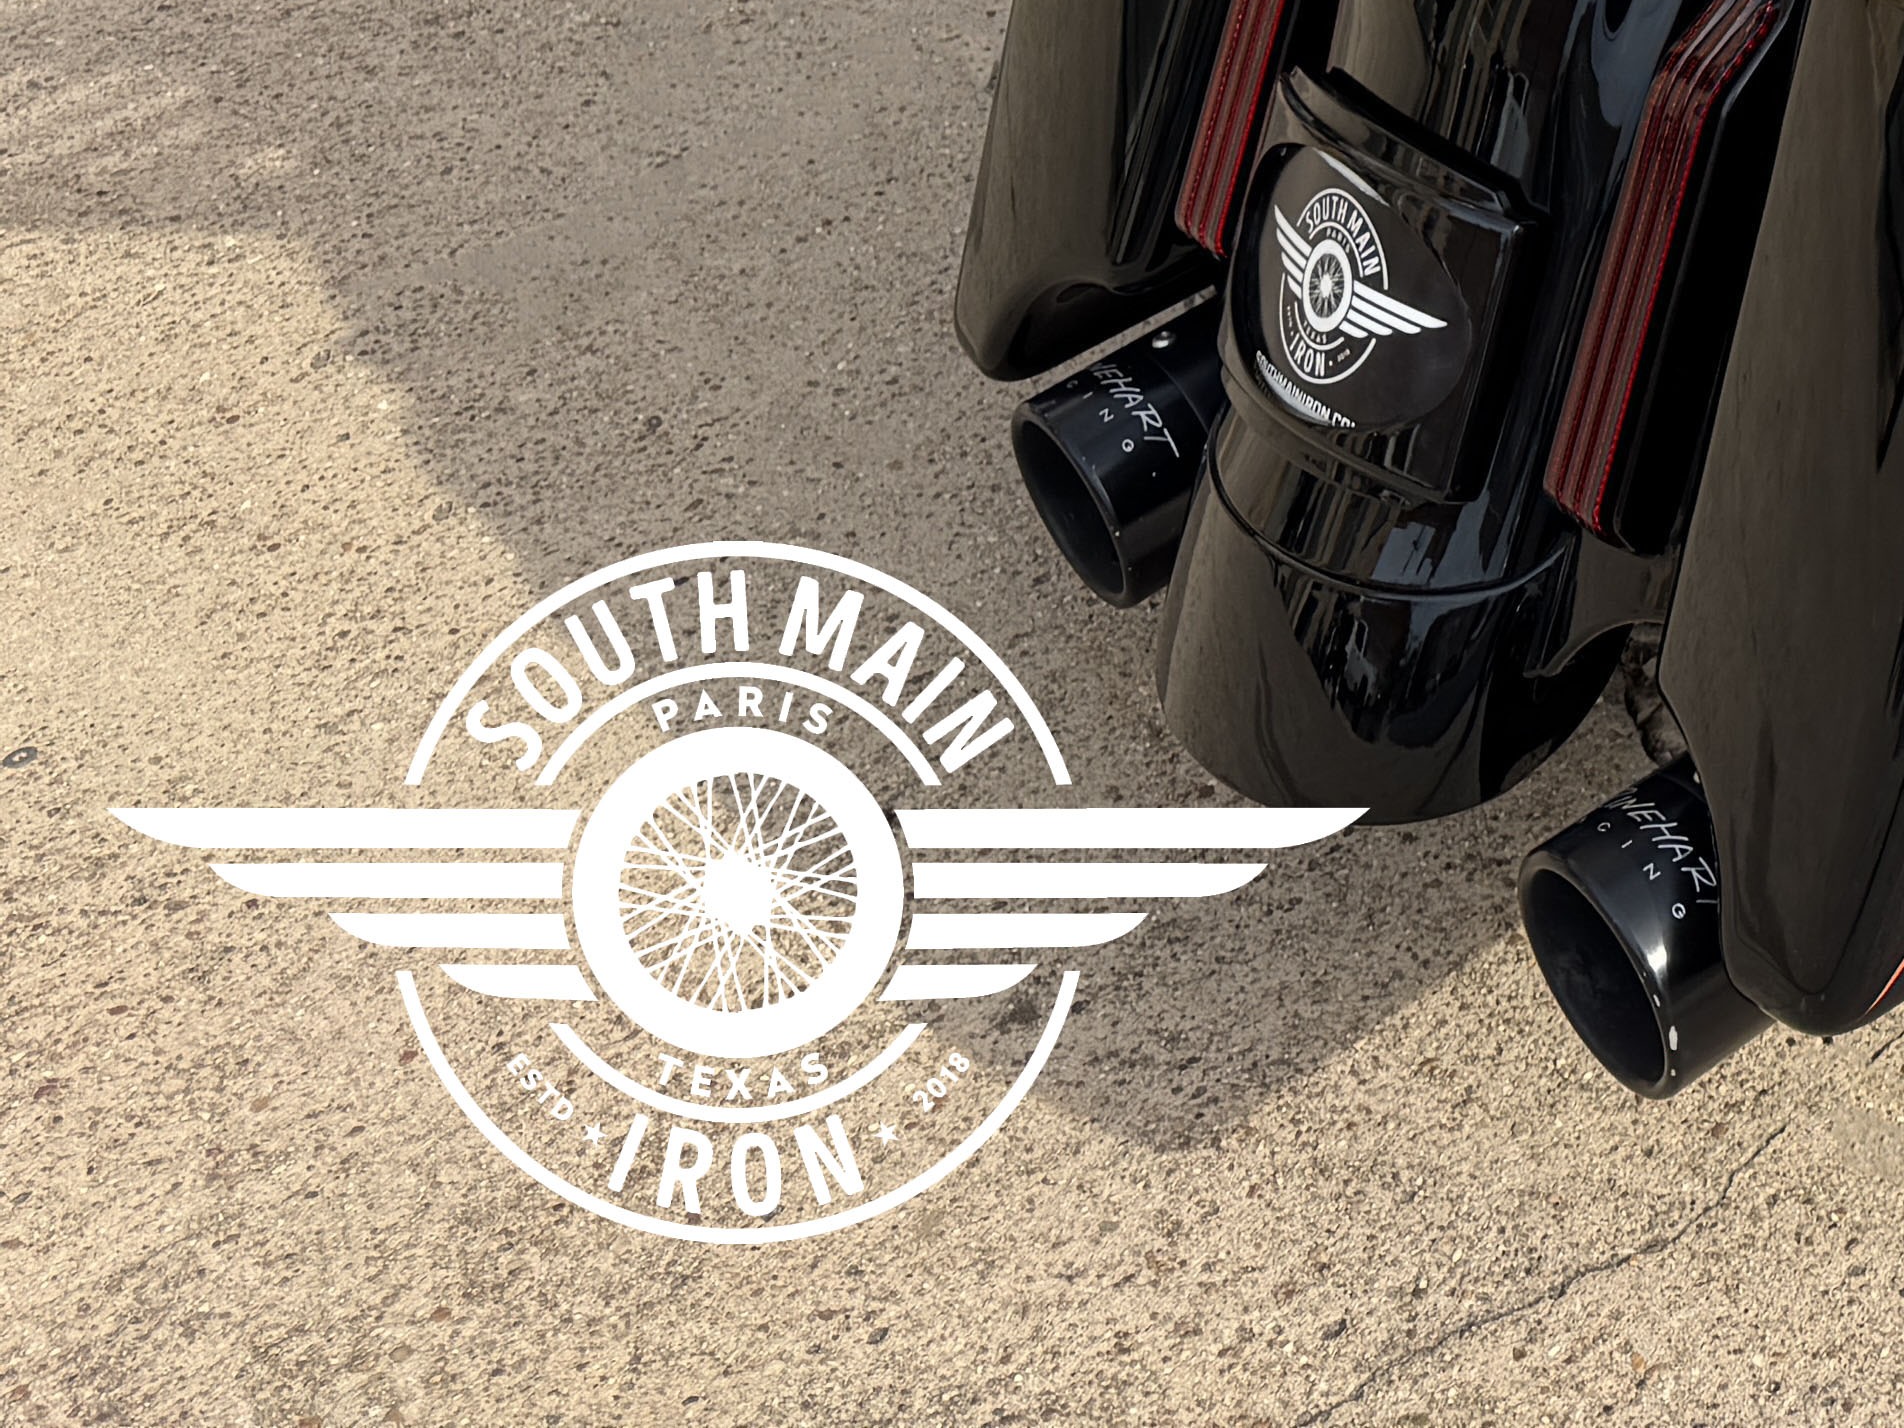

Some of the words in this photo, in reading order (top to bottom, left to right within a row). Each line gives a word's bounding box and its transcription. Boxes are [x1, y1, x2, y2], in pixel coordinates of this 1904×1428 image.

[1305, 194, 1348, 234] SOUTH
[1347, 209, 1381, 276] MAIN
[1256, 350, 1356, 428] SOUTHMAINIRON.CO
[1289, 332, 1326, 377] IRON
